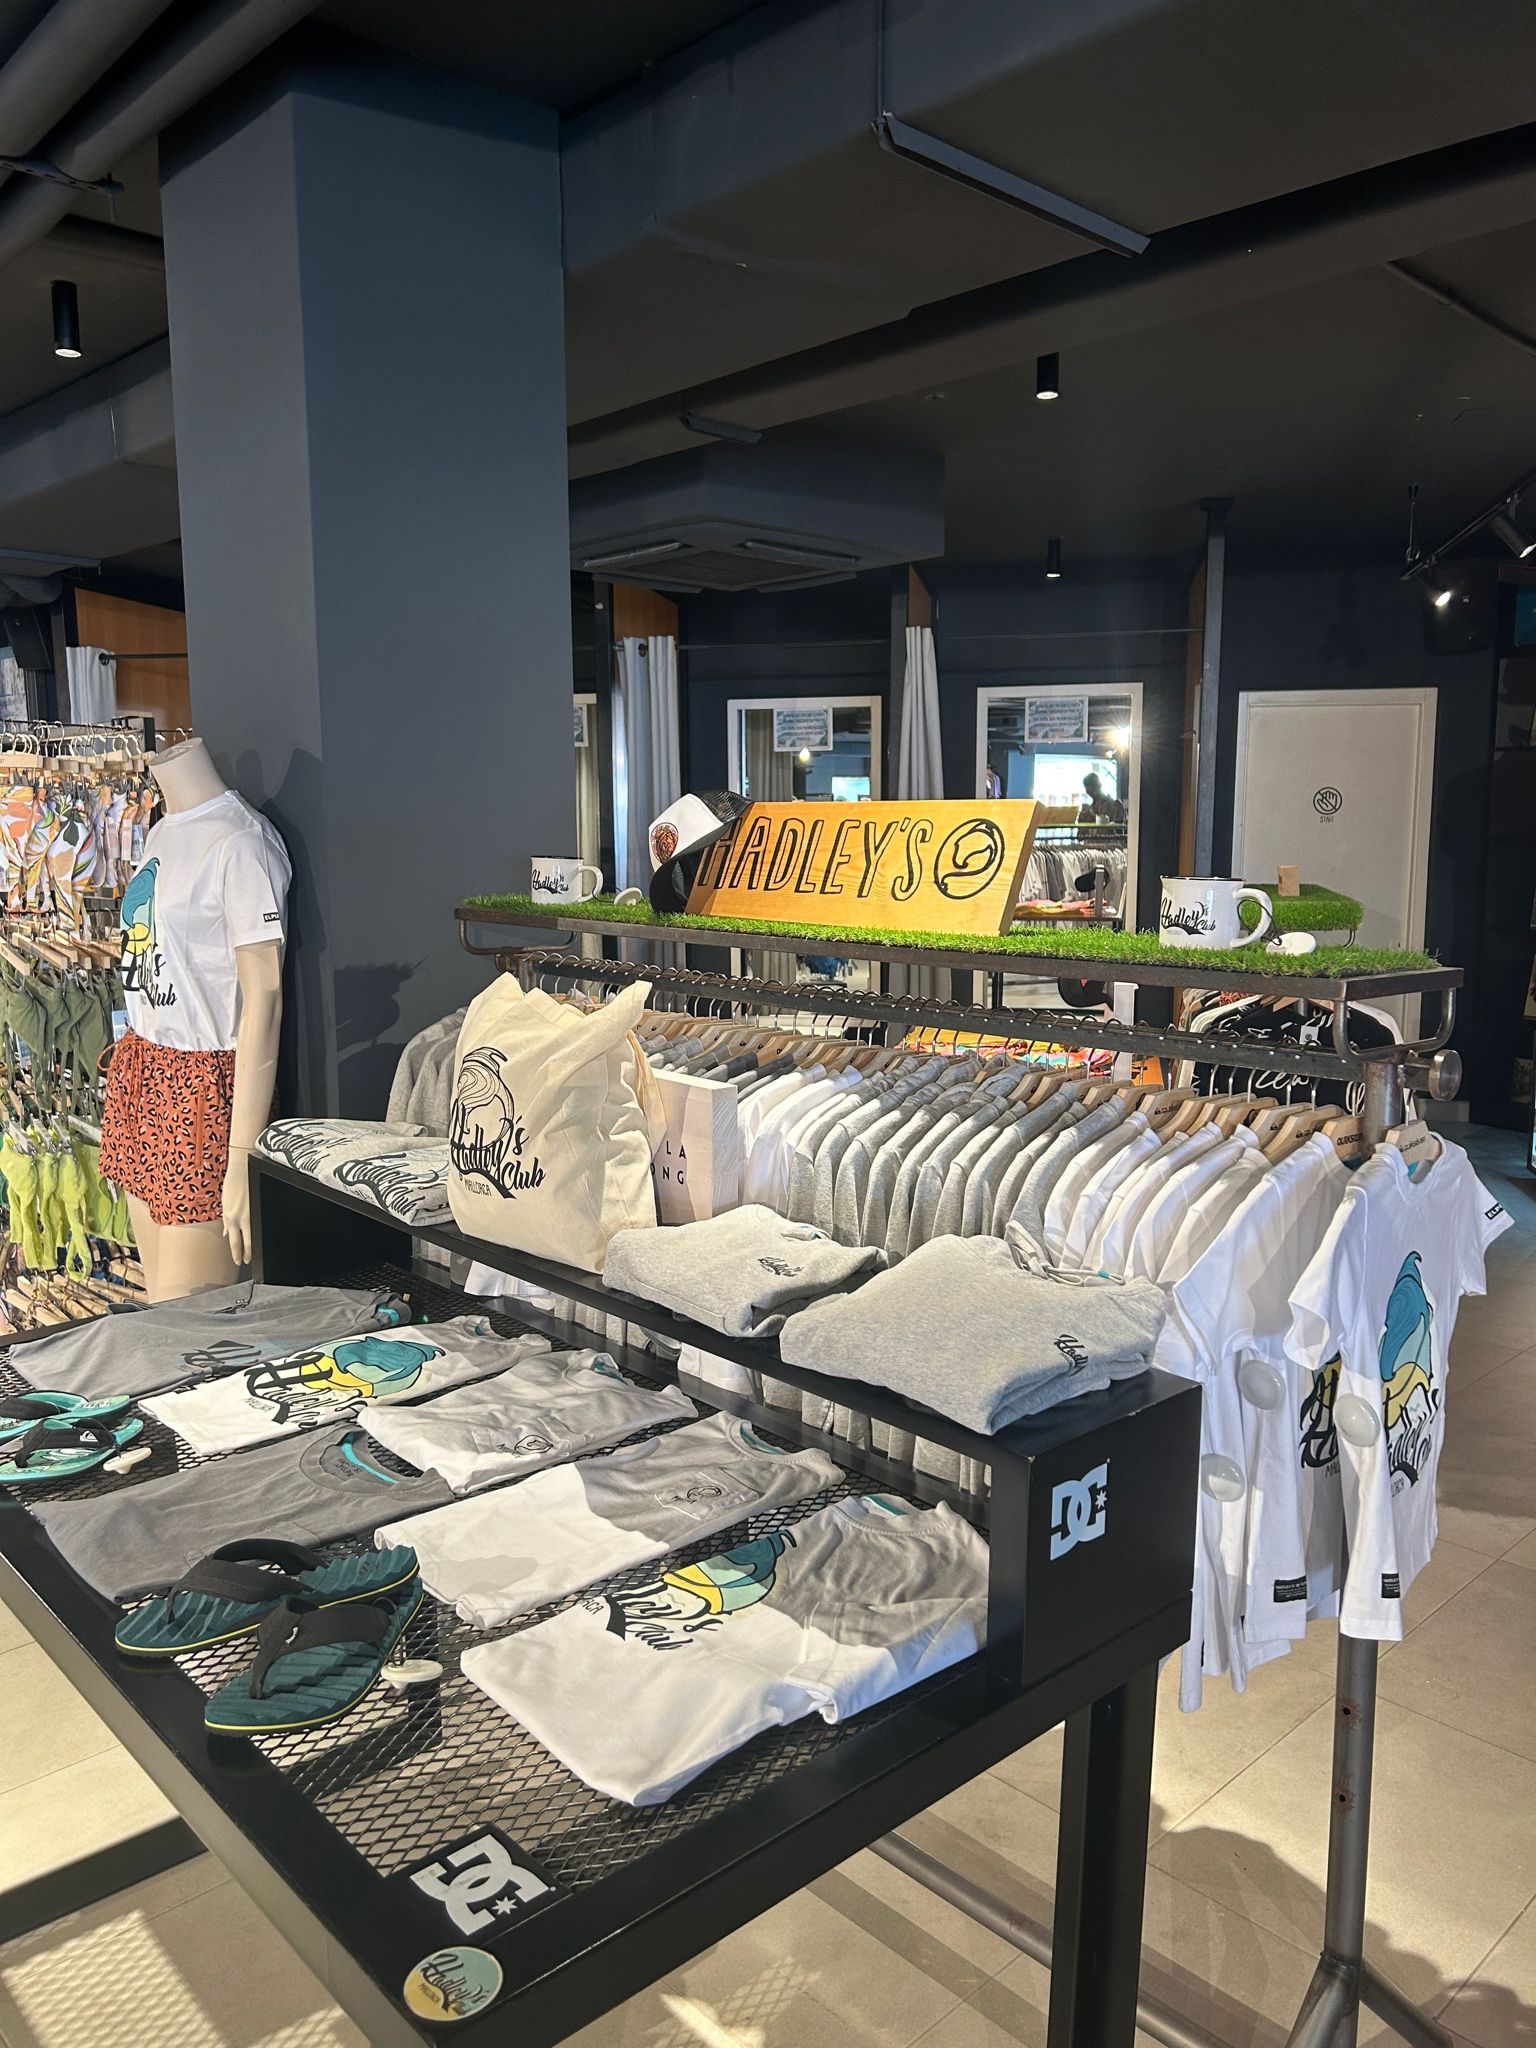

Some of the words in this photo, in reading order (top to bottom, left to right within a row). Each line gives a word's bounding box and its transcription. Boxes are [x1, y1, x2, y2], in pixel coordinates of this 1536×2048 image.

[696, 816, 934, 902] HADLEY'S
[1161, 897, 1209, 936] Hadley's
[451, 1098, 530, 1199] Hadley's
[502, 1157, 547, 1191] Club
[1050, 1462, 1108, 1561] DC
